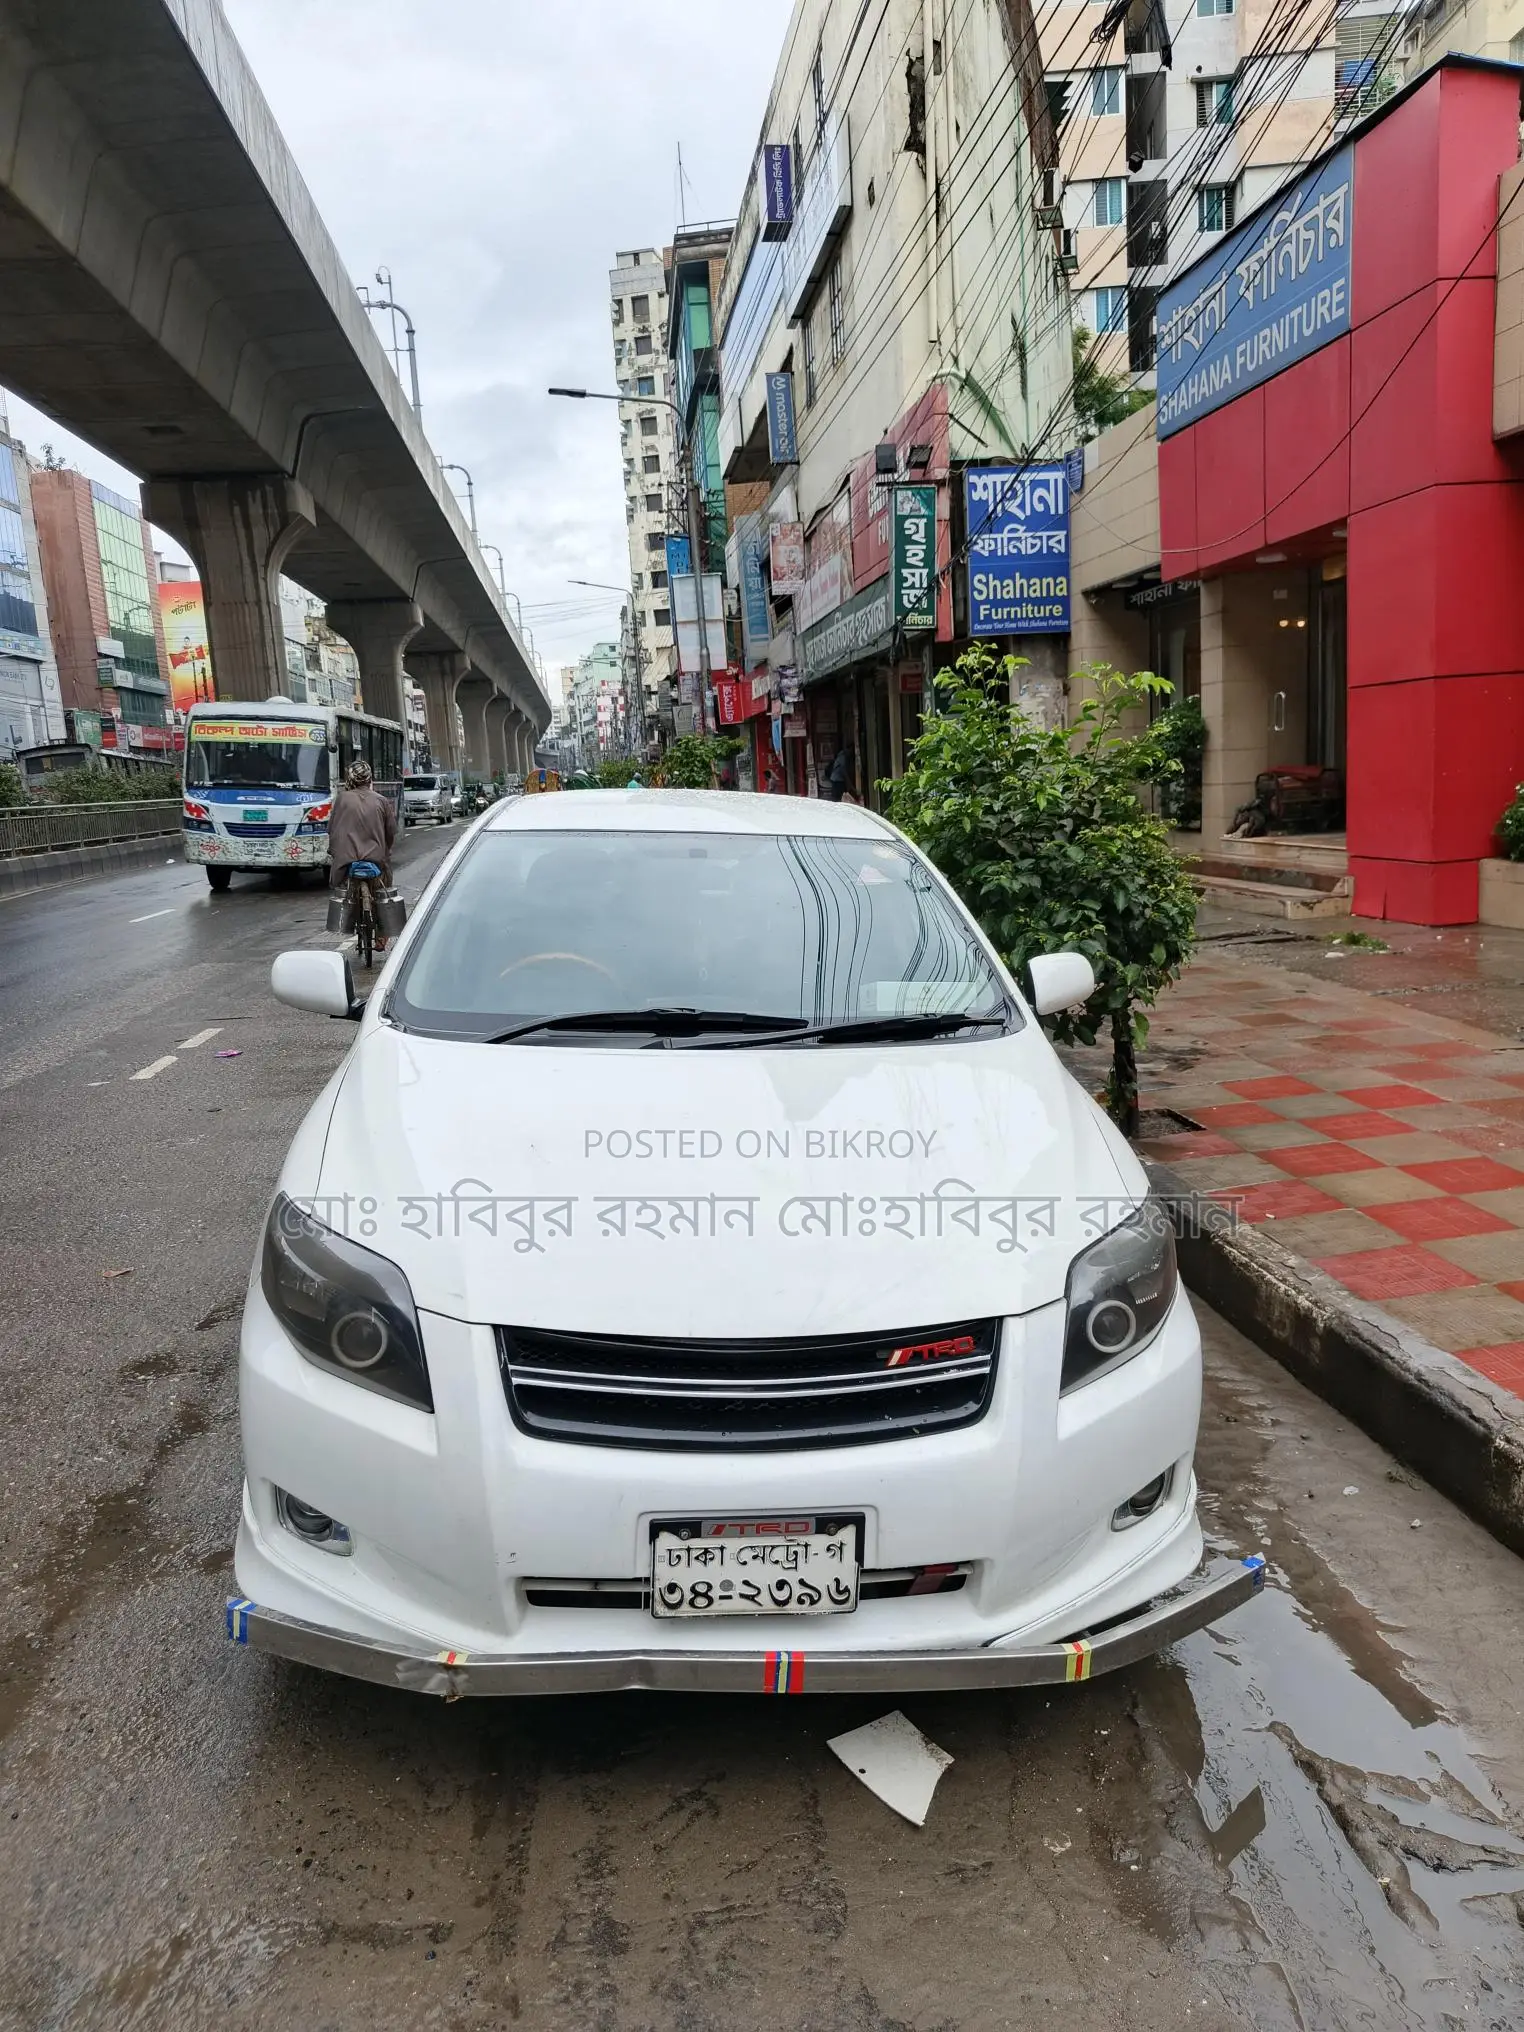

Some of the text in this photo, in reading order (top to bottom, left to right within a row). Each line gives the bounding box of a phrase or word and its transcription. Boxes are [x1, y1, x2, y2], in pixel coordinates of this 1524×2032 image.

[1159, 182, 1349, 364] শাহানা ফার্নিচার
[1159, 277, 1345, 425] SHAHANA FURNITURE
[969, 471, 1066, 520] শাহানা
[973, 523, 1067, 557] ফার্নিচার
[973, 572, 1068, 601] Shahana
[979, 603, 1063, 620] Furniture
[238, 724, 268, 737] অটো
[271, 725, 308, 739] সার্ভিস
[910, 1335, 977, 1361] TRD
[732, 1520, 811, 1536] TRD
[665, 1544, 728, 1569] ঢাকা
[659, 1576, 851, 1610] ৩৪-২৩৯৬
